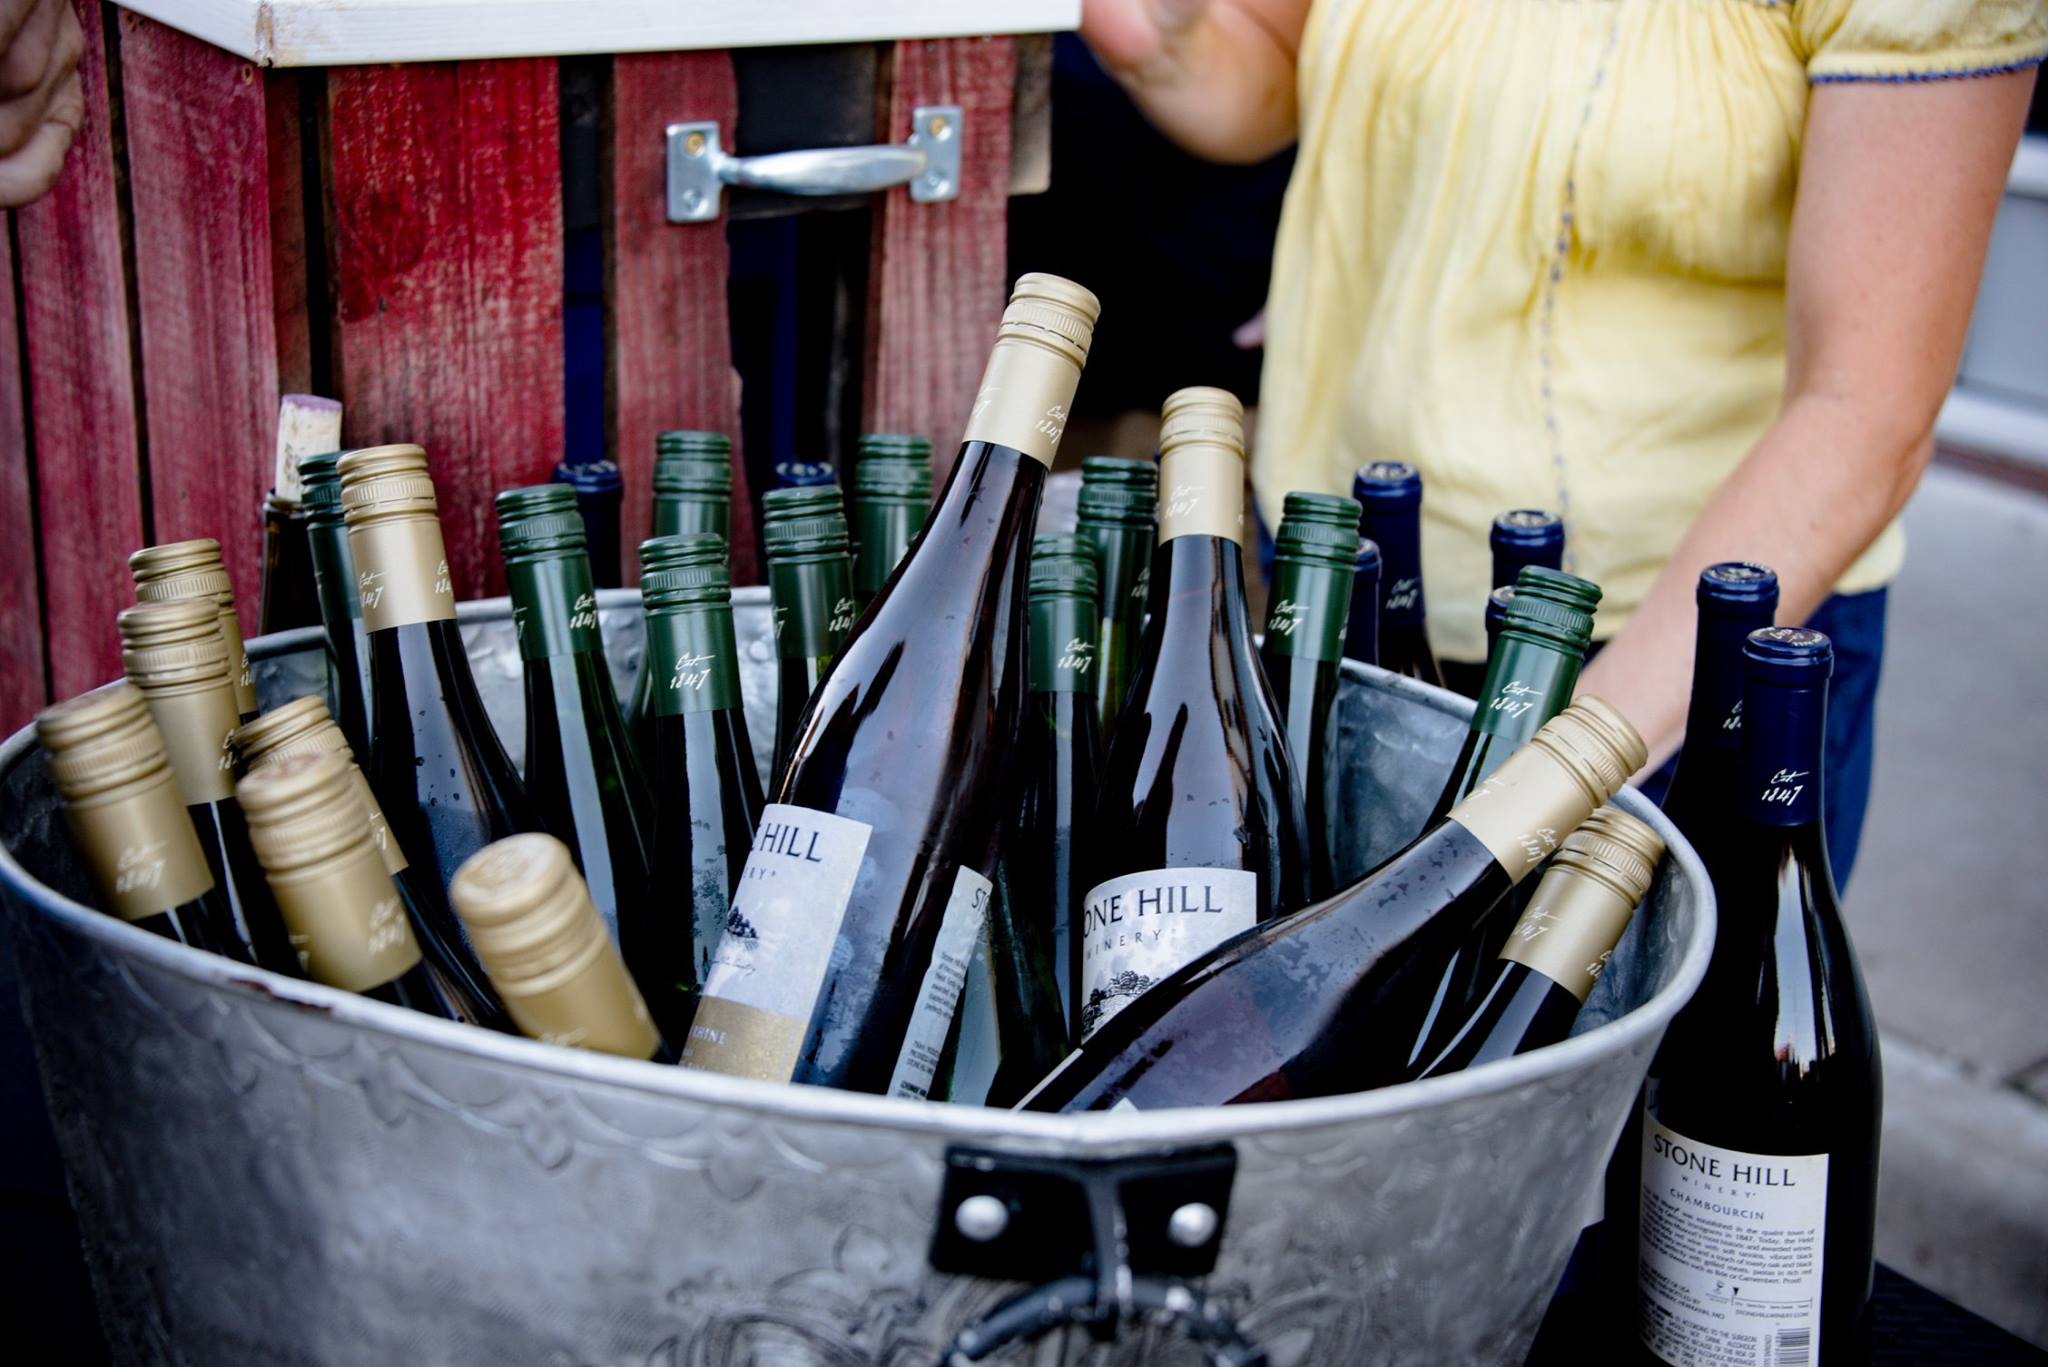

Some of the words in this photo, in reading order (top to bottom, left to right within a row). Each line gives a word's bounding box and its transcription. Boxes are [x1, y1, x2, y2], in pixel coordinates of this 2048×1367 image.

[1057, 655, 1092, 674] 1847
[670, 668, 711, 690] 1847
[1490, 697, 1534, 719] 1847
[1761, 785, 1803, 806] 1847
[759, 822, 822, 863] HILL
[1138, 886, 1222, 917] HILL
[1653, 1133, 1721, 1179] STONE
[1733, 1163, 1796, 1187] HILL
[1669, 1187, 1764, 1221] CHAMBOURCIN
